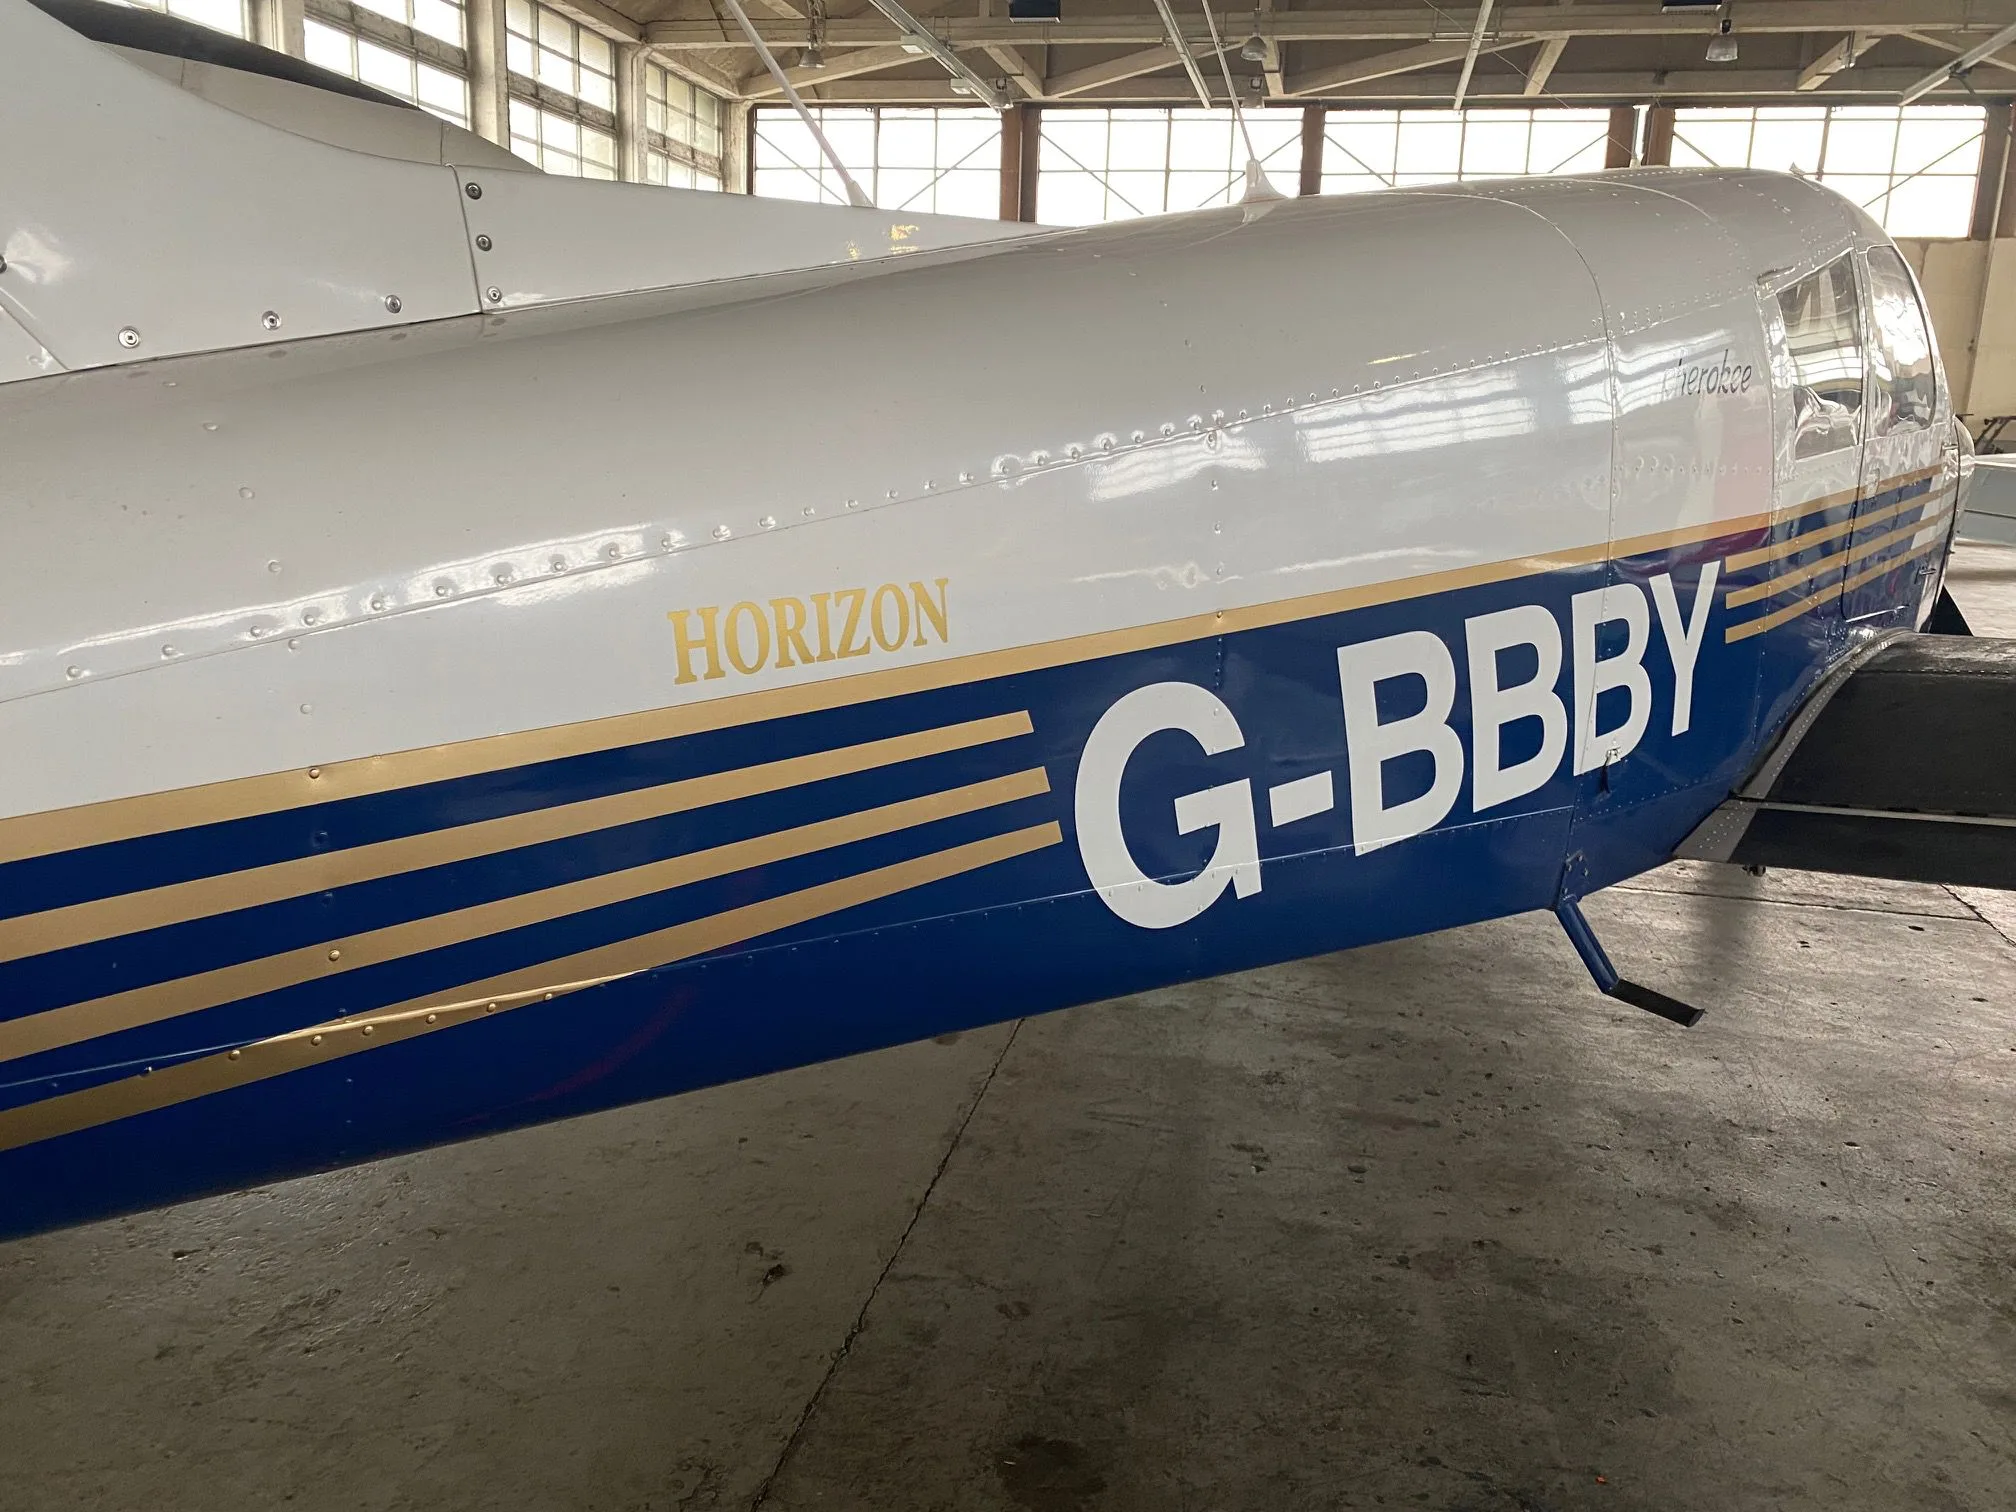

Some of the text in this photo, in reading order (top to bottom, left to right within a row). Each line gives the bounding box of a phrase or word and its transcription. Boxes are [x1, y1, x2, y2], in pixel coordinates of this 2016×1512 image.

[1662, 348, 1752, 396] herokee
[667, 577, 949, 685] HORIZON
[1074, 561, 1721, 929] G-BBBY
